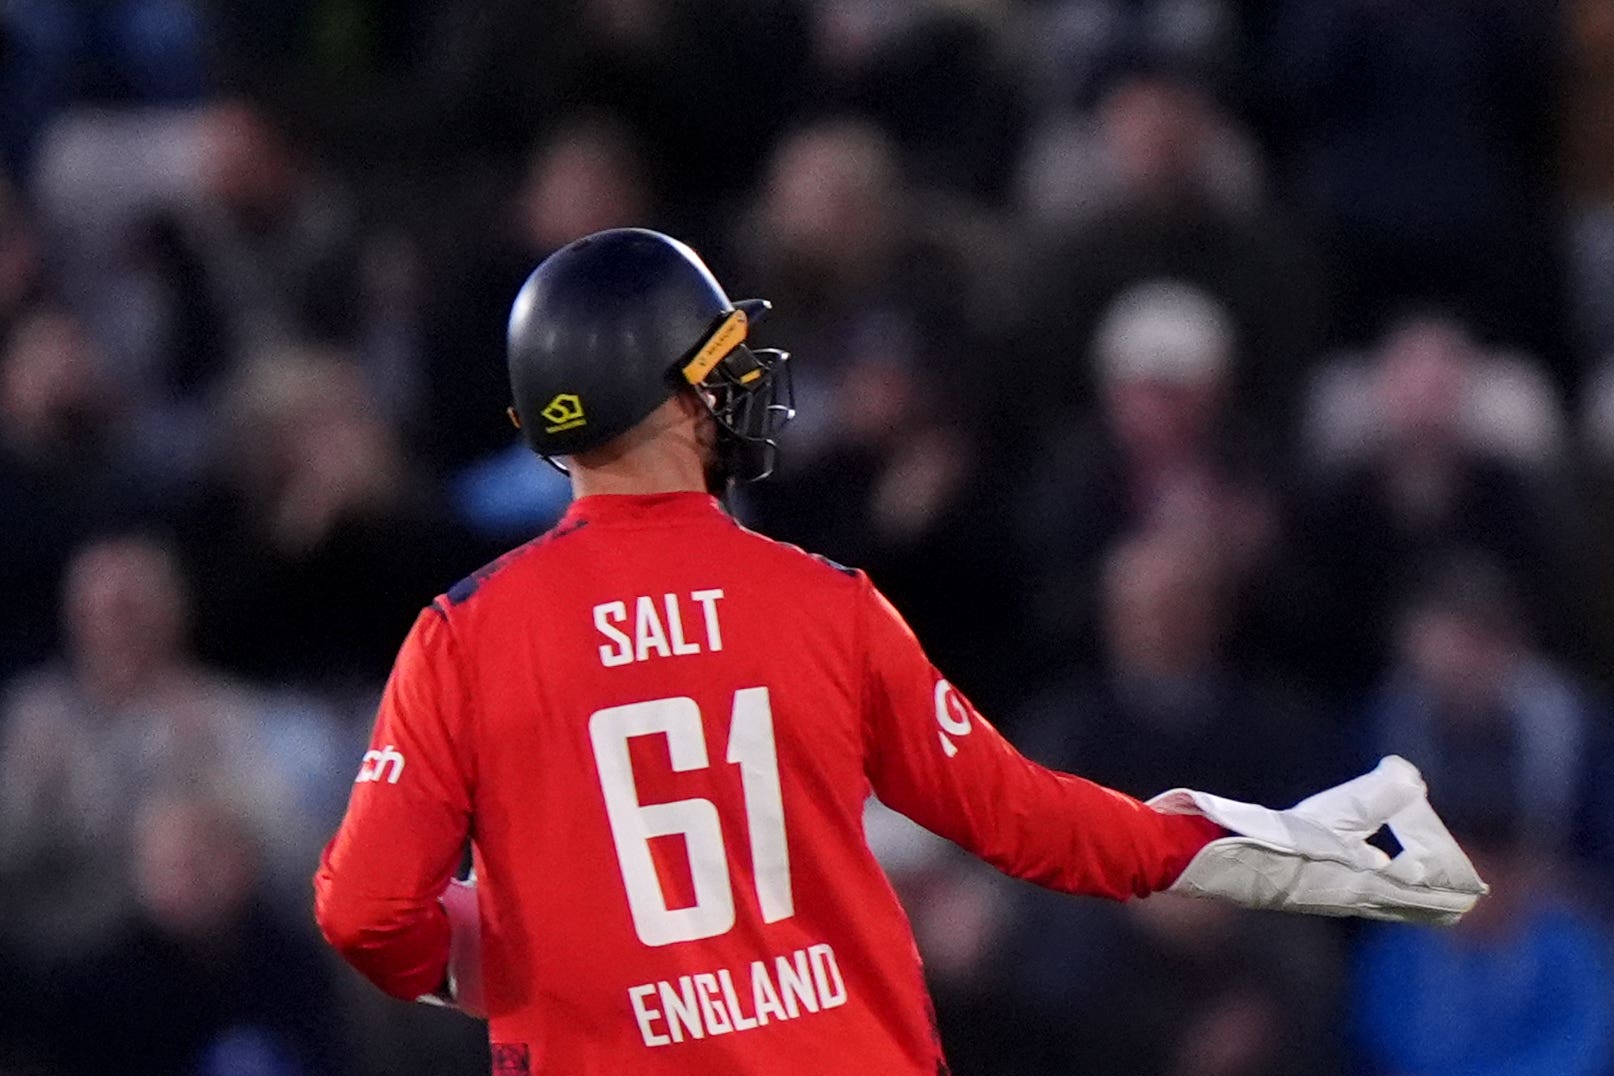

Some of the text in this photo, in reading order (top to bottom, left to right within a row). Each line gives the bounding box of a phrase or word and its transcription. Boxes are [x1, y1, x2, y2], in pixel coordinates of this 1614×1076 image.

[592, 588, 725, 668] SALT
[588, 686, 795, 947] 61
[628, 943, 848, 1047] ENGLAND
